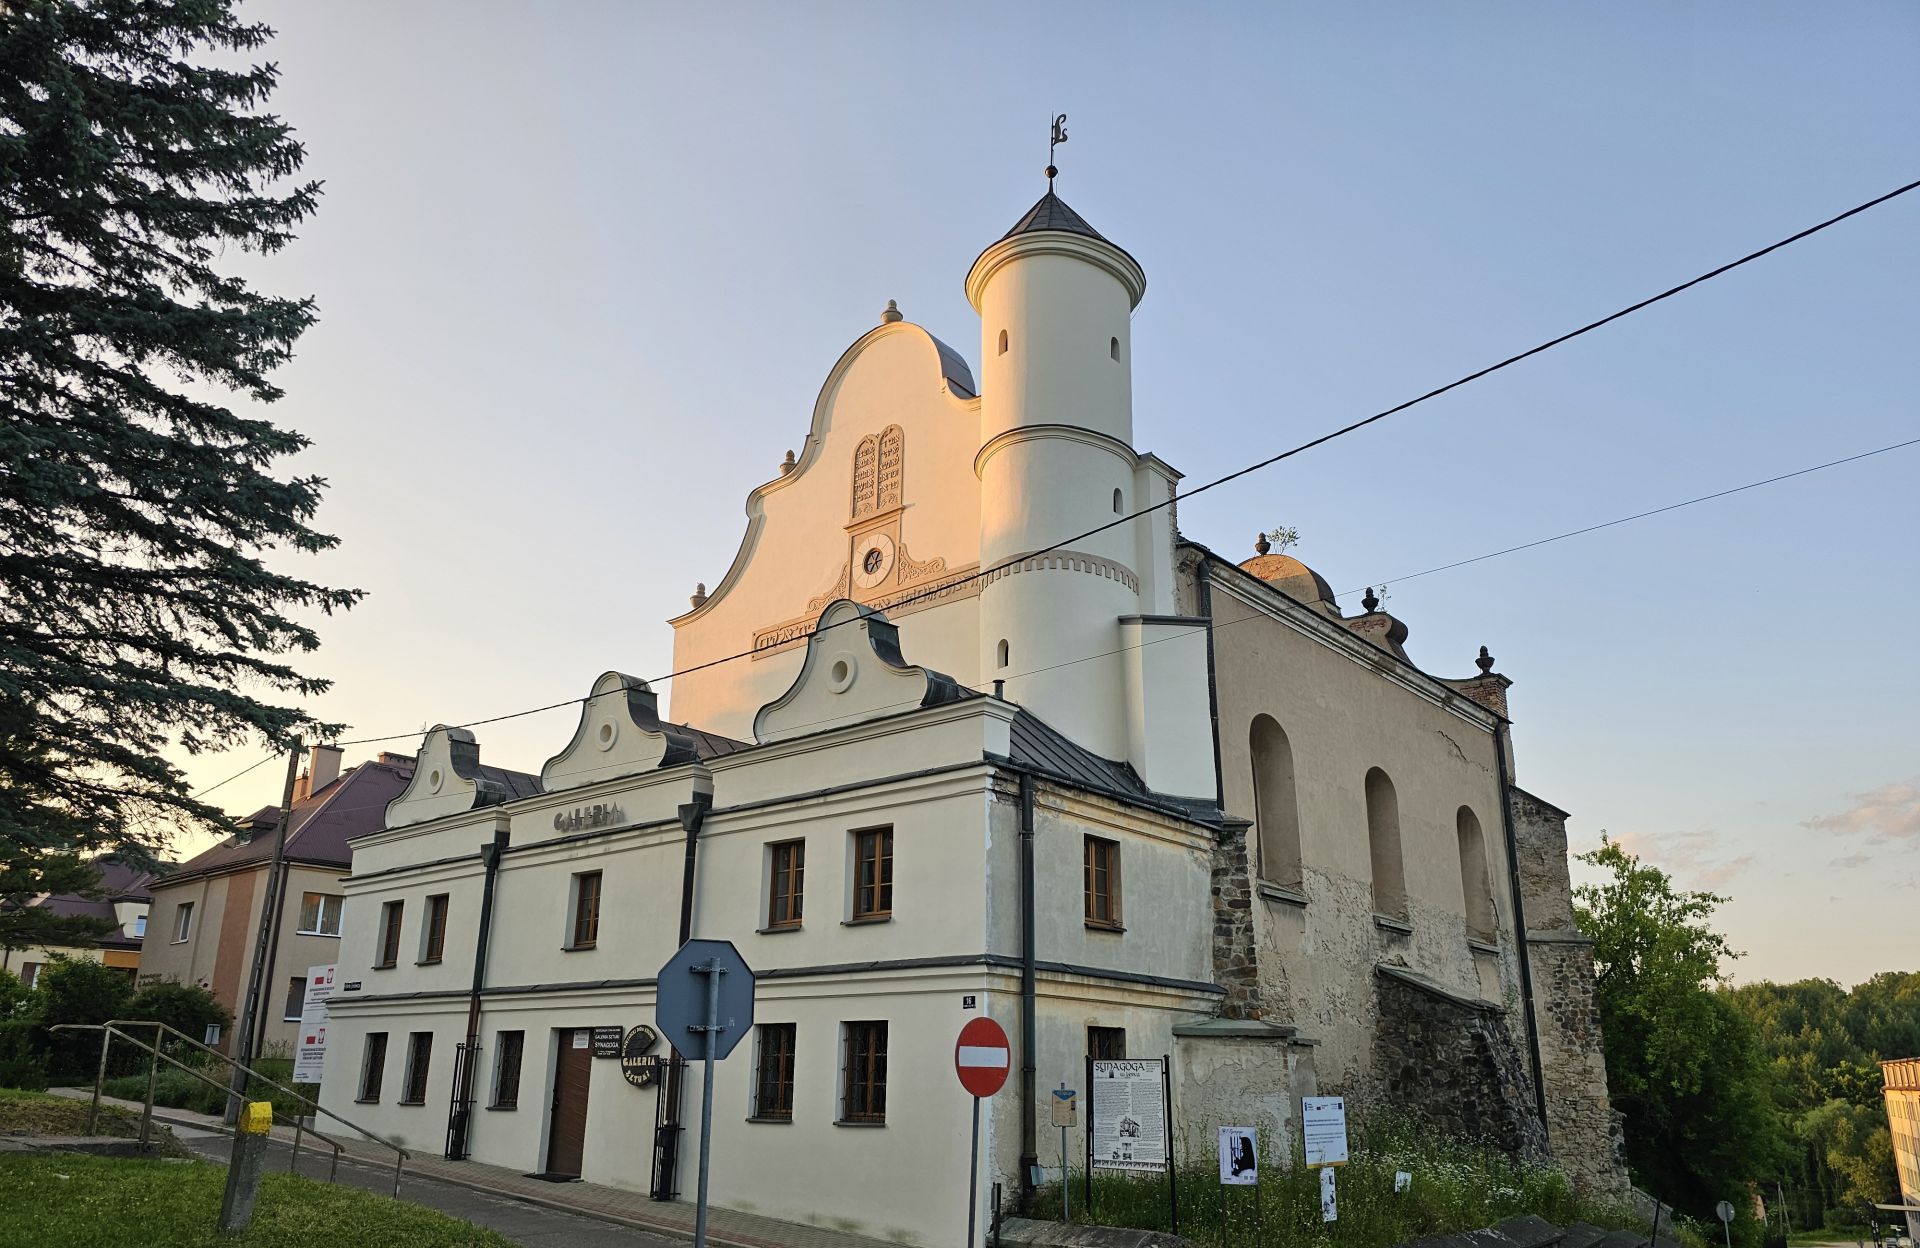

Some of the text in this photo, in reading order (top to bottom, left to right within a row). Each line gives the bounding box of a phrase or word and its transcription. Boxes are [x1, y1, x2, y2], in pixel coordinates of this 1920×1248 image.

[554, 801, 624, 832] GALERIA
[623, 1057, 655, 1066] GALERIA
[1095, 1063, 1145, 1073] SYNAGOGA
[626, 1070, 650, 1083] SZTUKI
